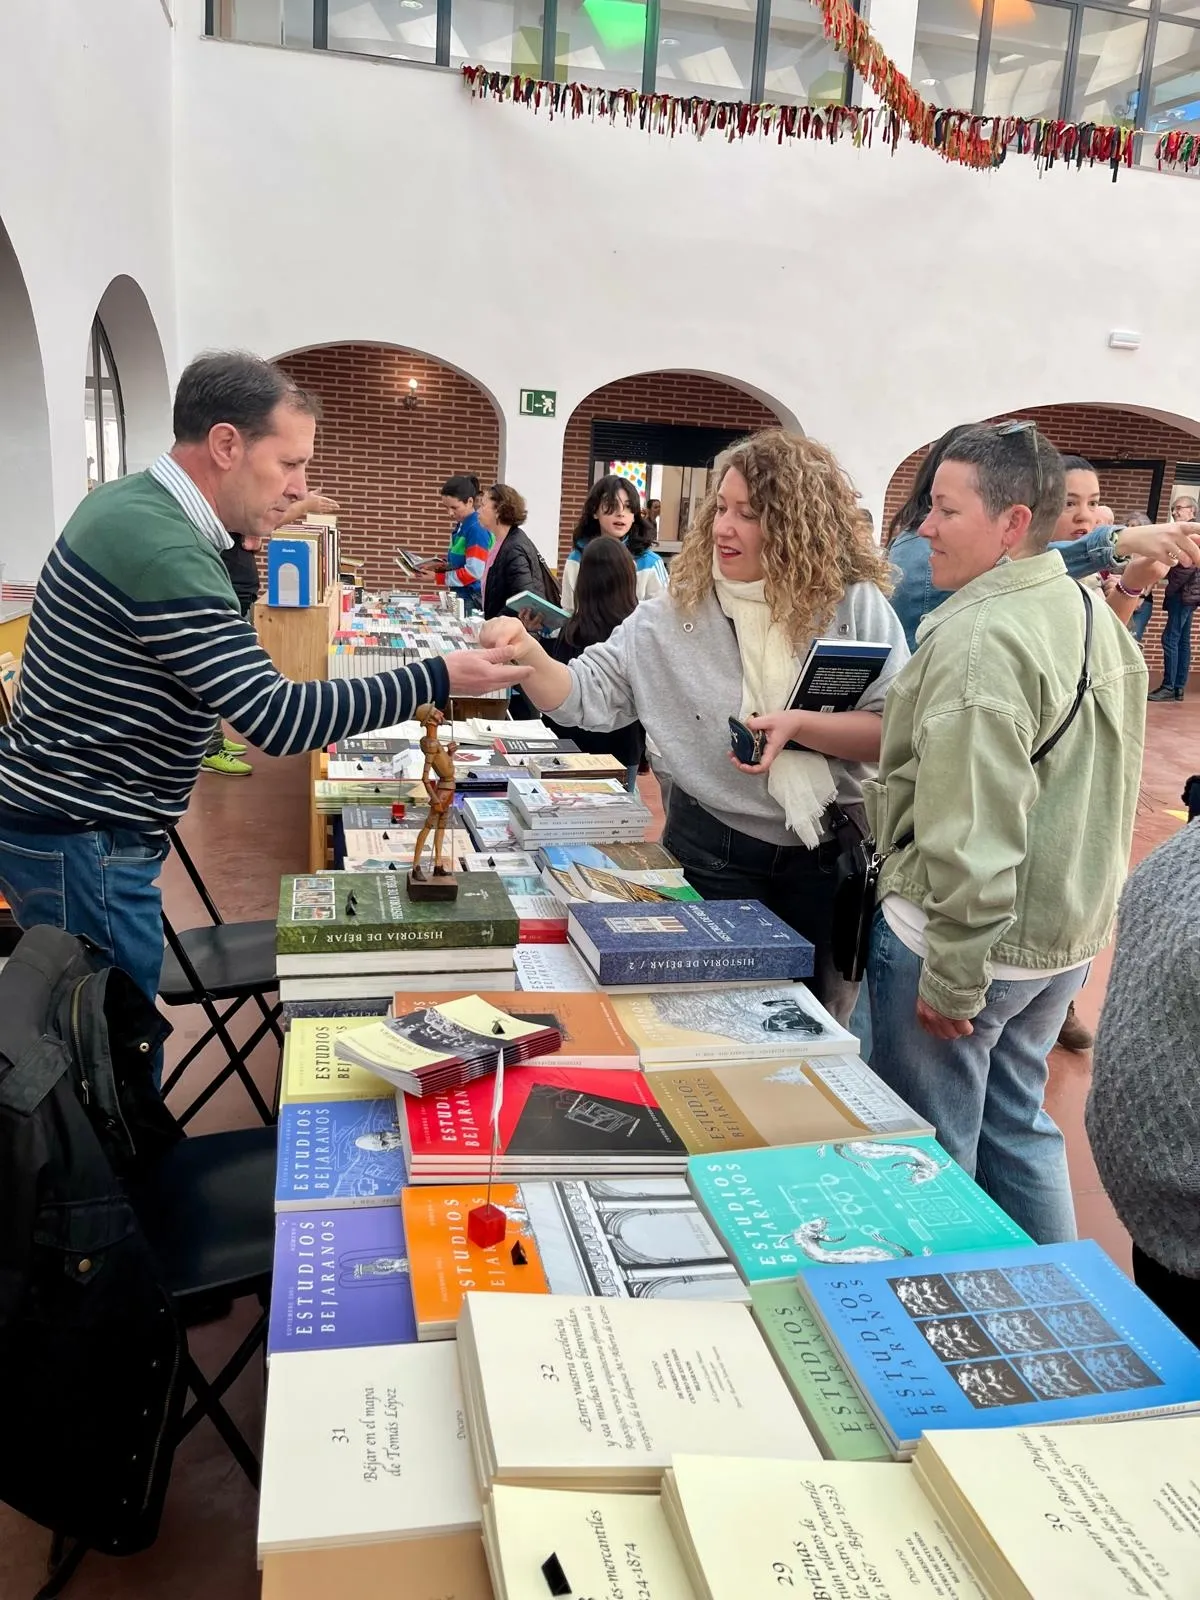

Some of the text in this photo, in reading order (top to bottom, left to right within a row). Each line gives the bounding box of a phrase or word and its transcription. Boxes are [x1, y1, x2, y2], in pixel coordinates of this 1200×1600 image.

[301, 935, 306, 943] 1
[327, 933, 362, 945] BÉJAR
[367, 933, 382, 942] DE
[386, 931, 443, 942] HISTORIA
[518, 951, 545, 989] ESTUDIOS
[629, 961, 635, 970] 2
[650, 960, 684, 971] BÉJAR
[686, 960, 699, 969] DE
[703, 957, 755, 968] HISTORIA
[315, 1026, 331, 1080] ESTUDIOS
[435, 1090, 458, 1142] ESTUDI
[453, 1086, 481, 1148] BEJARAN
[672, 1078, 726, 1140] ESTUDIOS
[696, 1077, 745, 1138] BEJARANOS
[293, 1109, 311, 1191] ESTUDIOS
[314, 1108, 334, 1189] BEJARANOS
[706, 1164, 778, 1266] ESTUDIOS
[725, 1163, 798, 1264] BEJARANOS
[471, 1197, 506, 1287] EJARS
[294, 1222, 315, 1336] ESTUDIOS
[320, 1220, 339, 1333] BEJARANOS
[829, 1280, 929, 1417] ESTUDIOS
[848, 1278, 949, 1414] BEJARANOS
[540, 1364, 560, 1382] 32
[554, 1319, 593, 1433] «Entre vuestra excelencia
[583, 1362, 596, 1383] veces
[774, 1307, 863, 1433] ESTUDIOS
[796, 1305, 878, 1431] BEJARANOS
[586, 1385, 608, 1421] muchas
[331, 1427, 350, 1444] 31
[358, 1387, 384, 1483] Béjar en el mapa
[381, 1387, 404, 1477] de Tomás López
[455, 1409, 467, 1441] Discurso
[601, 1424, 613, 1439] sea
[606, 1439, 623, 1449] y
[1058, 1467, 1076, 1479] de
[818, 1483, 847, 1516] 1923)
[1046, 1476, 1077, 1506] Buen
[1065, 1479, 1104, 1516] Manuel
[1090, 1492, 1109, 1503] de
[798, 1518, 817, 1531] de
[799, 1480, 838, 1538] Crotontilo
[1044, 1513, 1073, 1534] 30
[1063, 1508, 1093, 1528] del
[1099, 1516, 1119, 1535] don
[839, 1518, 864, 1551] Béjar
[913, 1531, 935, 1562] ESTUDIOS
[1085, 1528, 1121, 1564] morir
[1115, 1536, 1129, 1548] en
[1118, 1526, 1137, 1538] de
[811, 1535, 837, 1571] relatos
[834, 1541, 860, 1581] Castro,
[894, 1549, 921, 1586] Discurso
[933, 1546, 961, 1584] BEJARANOS
[771, 1562, 794, 1587] 29
[791, 1541, 833, 1600] Briznas
[861, 1561, 886, 1588] 1867
[916, 1556, 938, 1586] INGRESO
